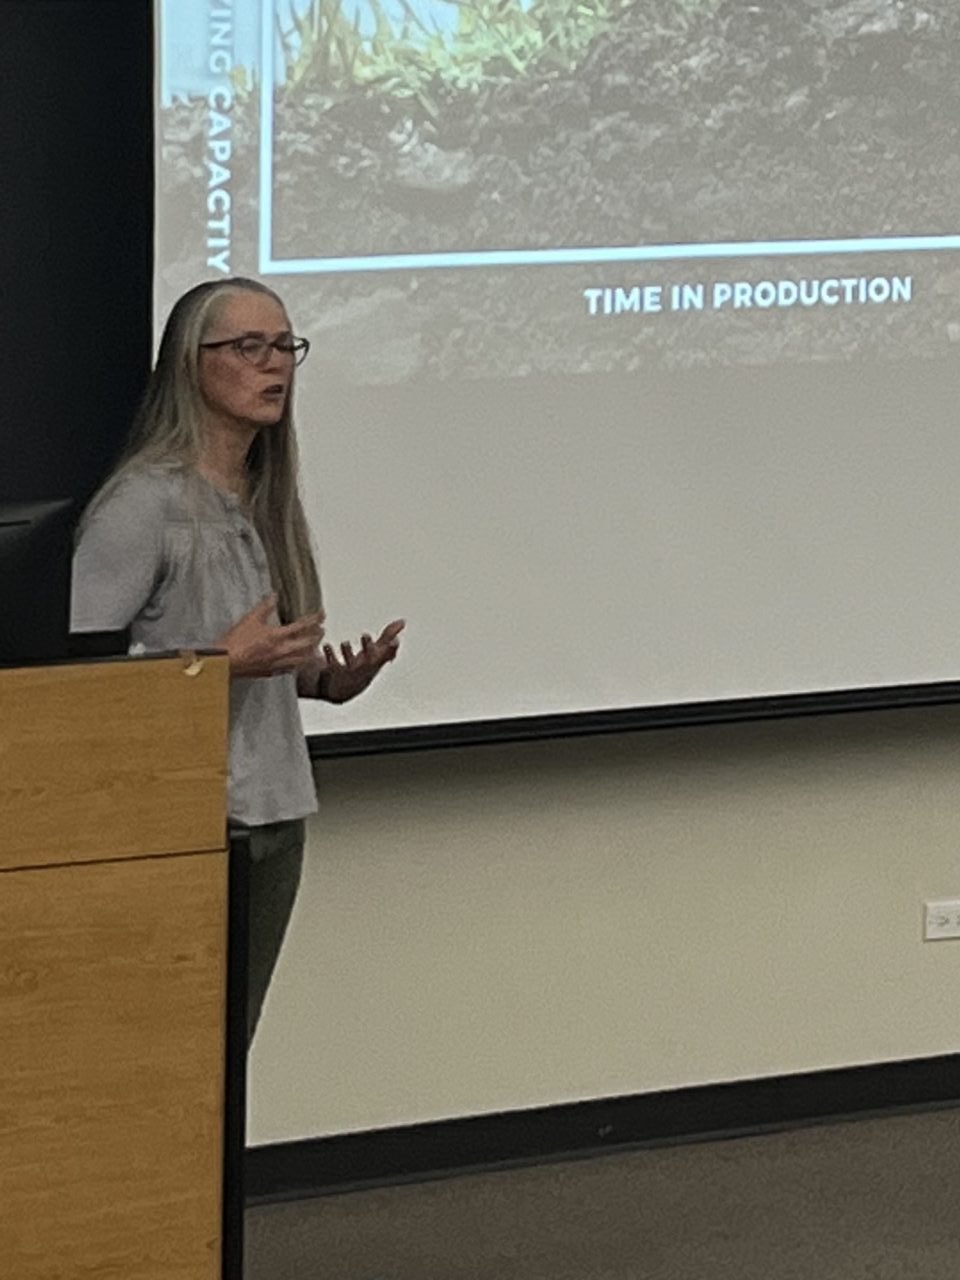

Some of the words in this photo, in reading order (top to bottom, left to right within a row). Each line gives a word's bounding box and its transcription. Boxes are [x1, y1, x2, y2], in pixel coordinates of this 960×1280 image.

[205, 86, 234, 275] CAPACTIY
[583, 286, 662, 315] TIME
[671, 284, 704, 311] IN
[713, 276, 913, 310] PRODUCTION
